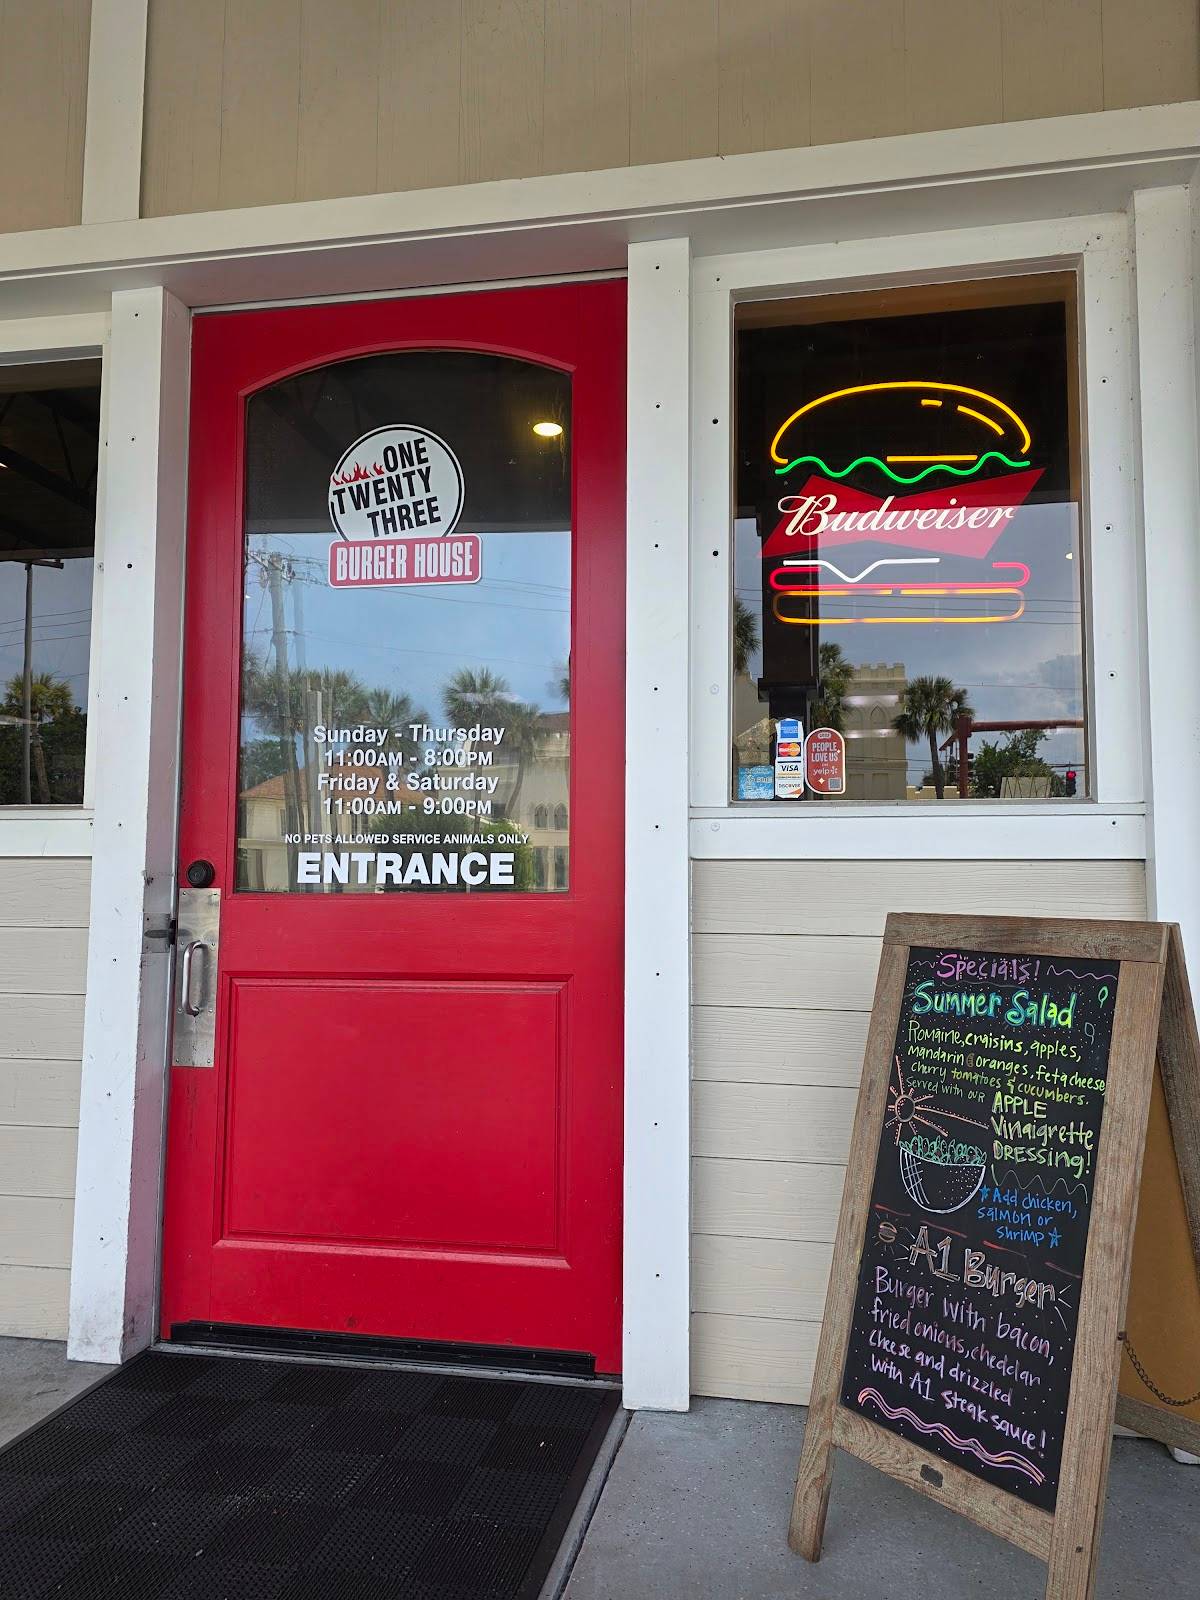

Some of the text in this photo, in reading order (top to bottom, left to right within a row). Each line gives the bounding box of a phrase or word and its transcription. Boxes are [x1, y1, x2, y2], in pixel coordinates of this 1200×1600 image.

[383, 437, 429, 473] ONE
[333, 466, 431, 515] TWENTY
[367, 496, 441, 537] THREE
[777, 494, 1014, 536] Budweiser
[336, 541, 473, 581] BURGER HOUSE
[313, 725, 388, 746] Sunday
[409, 724, 505, 745] Thursday
[812, 742, 837, 752] PEOPLE
[324, 749, 403, 767] 11:00AM
[424, 749, 493, 767] 8:00PM
[781, 764, 799, 772] VISA
[811, 752, 839, 762] LOVE US
[317, 772, 499, 794] Friday & Saturday
[813, 767, 830, 776] yelp
[323, 798, 401, 815] 11:00AM
[423, 797, 491, 815] 9:00PM
[285, 834, 529, 844] NO PETS ALLOWED SERVICE ANIMALS ONLY
[297, 852, 515, 885] ENTRANCE
[937, 953, 1040, 981] Specials!
[912, 980, 1077, 1029] Summer Salad
[1030, 1040, 1081, 1062] apples,
[942, 1084, 963, 1098] with
[951, 1068, 1001, 1088] tomatoes
[992, 1091, 1047, 1118] APPLE
[991, 1115, 1094, 1150] Vinaigrette
[993, 1188, 1077, 1219] Add chicken,
[1038, 1215, 1053, 1226] or
[908, 1225, 1056, 1311] A1 Burger
[871, 1297, 911, 1330] fried
[875, 1266, 934, 1308] Burger
[997, 1312, 1054, 1366] bacon,
[909, 1373, 935, 1402] A1
[914, 1350, 944, 1379] and
[949, 1364, 1013, 1406] drizzled
